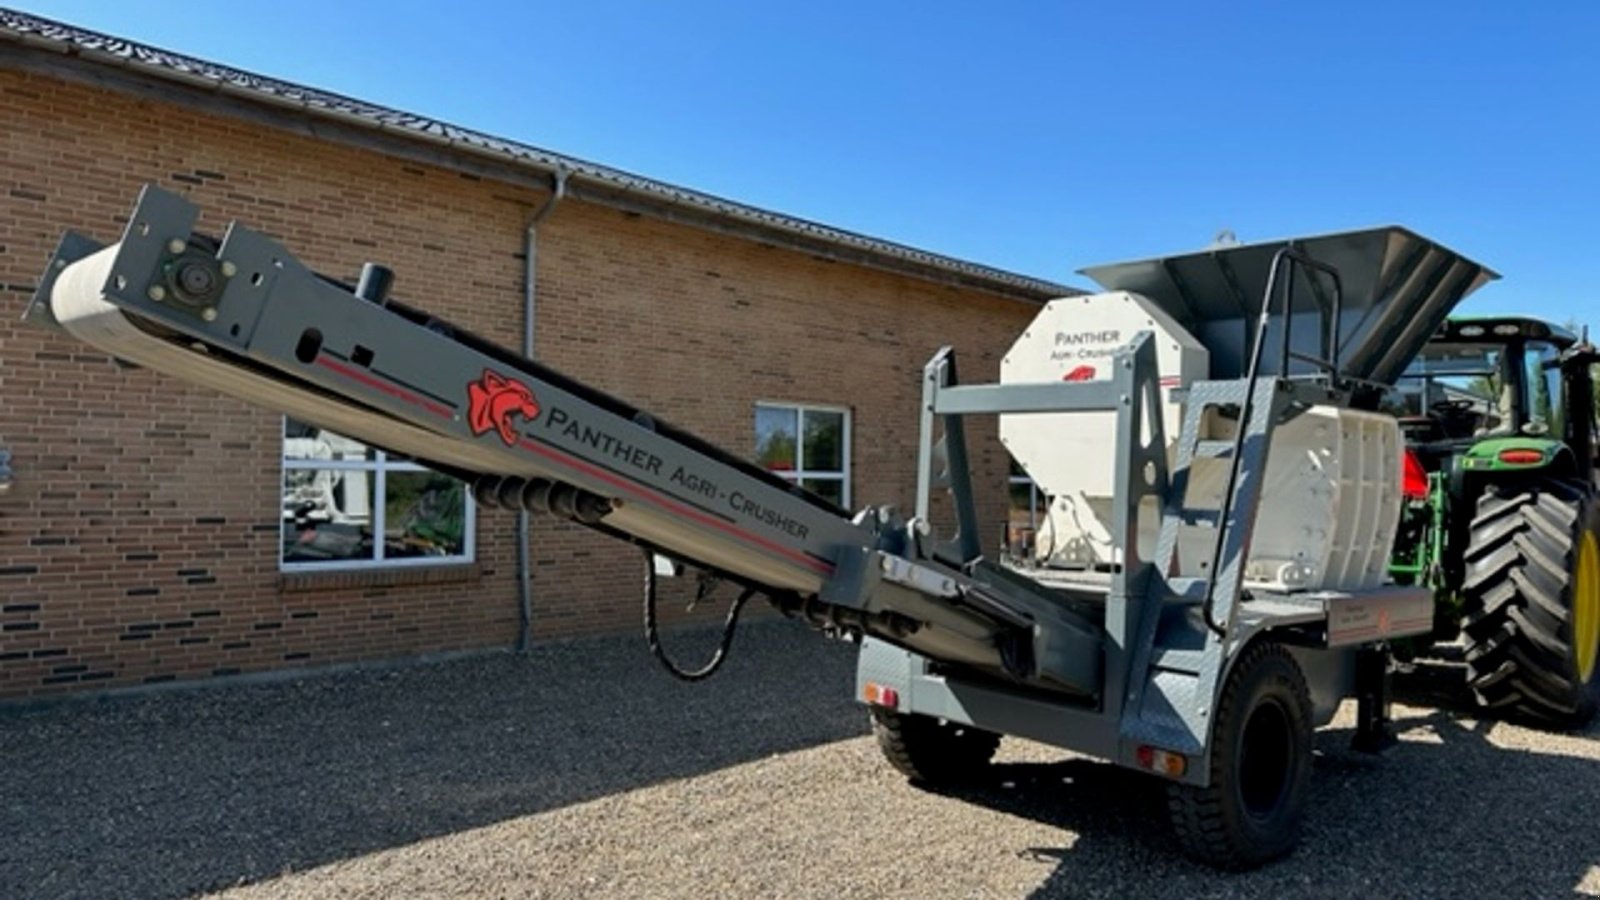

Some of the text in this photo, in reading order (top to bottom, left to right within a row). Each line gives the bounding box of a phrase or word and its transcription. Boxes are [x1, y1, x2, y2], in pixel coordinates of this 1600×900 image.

[1054, 330, 1120, 346] PANTHER
[545, 406, 663, 475] PANTHER
[669, 466, 718, 498] AGRI
[729, 490, 809, 540] CRUSHER
